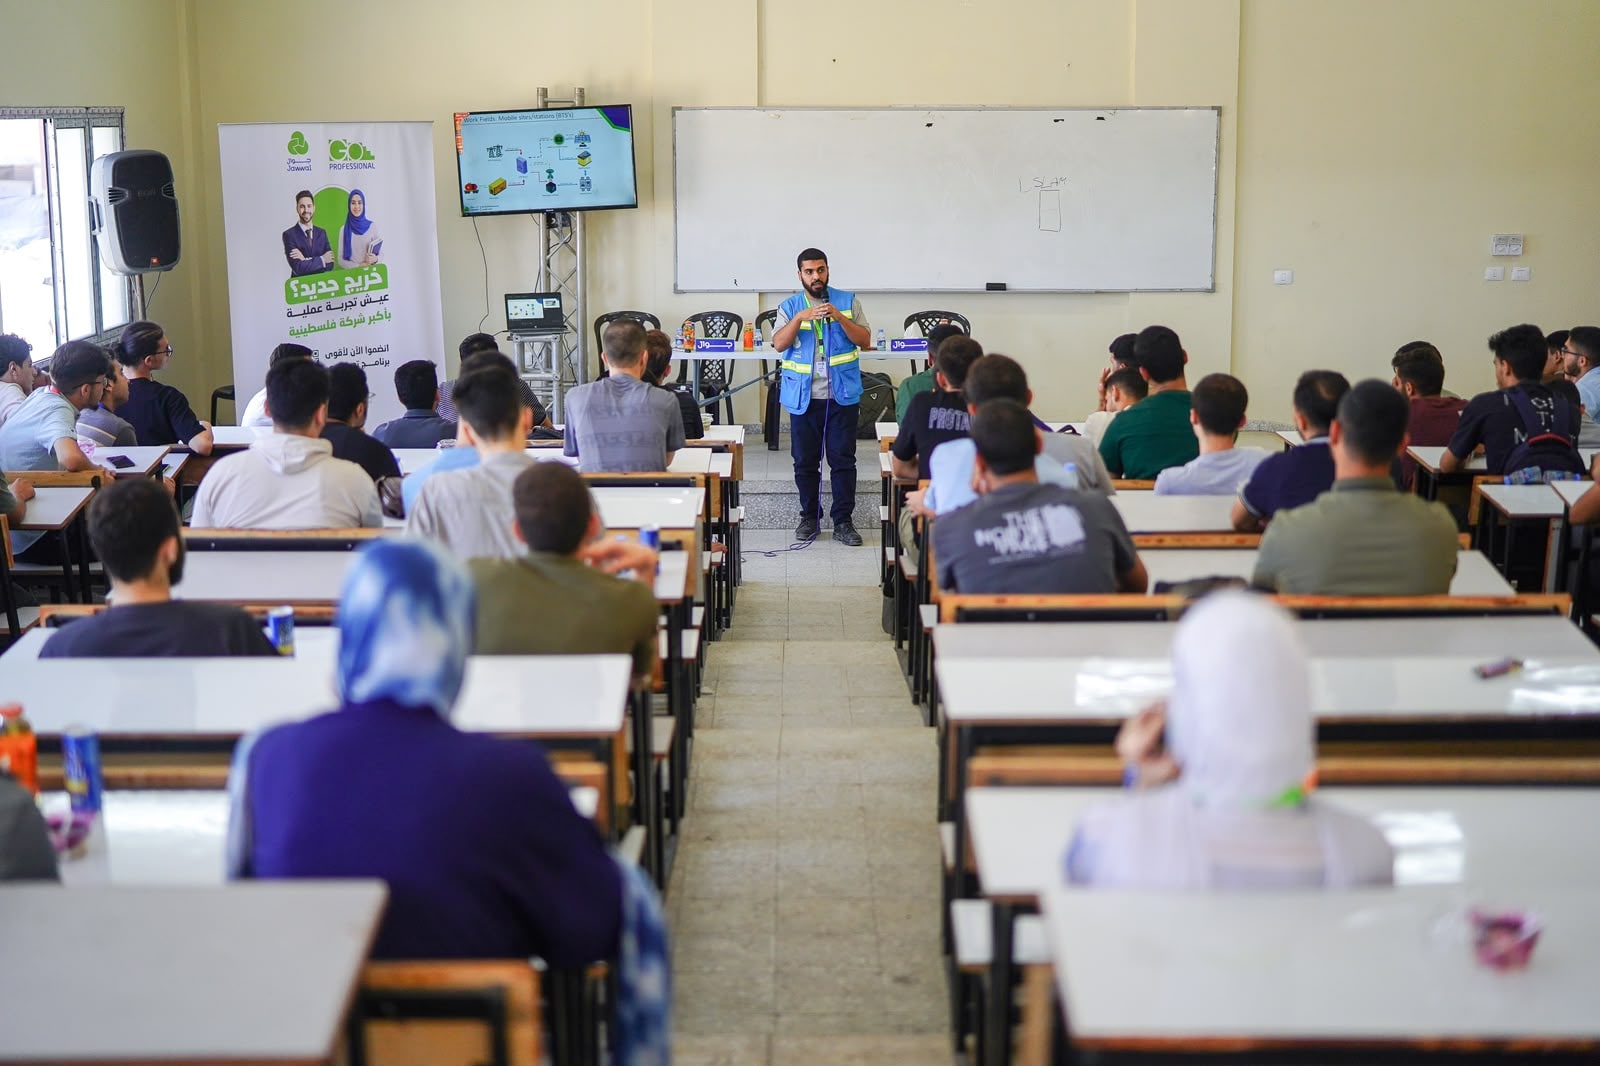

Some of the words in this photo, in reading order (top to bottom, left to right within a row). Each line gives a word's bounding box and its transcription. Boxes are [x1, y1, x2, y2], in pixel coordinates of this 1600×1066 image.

[498, 114, 517, 122] Mobile
[329, 162, 376, 170] PROFESSIONAL
[289, 279, 338, 300] جديد؟
[326, 296, 357, 311] تجربة
[286, 305, 323, 319] عملية
[367, 307, 391, 325] بأكبر
[339, 312, 366, 328] شركة
[289, 320, 336, 338] فلسطينية
[365, 344, 389, 355] انضموا
